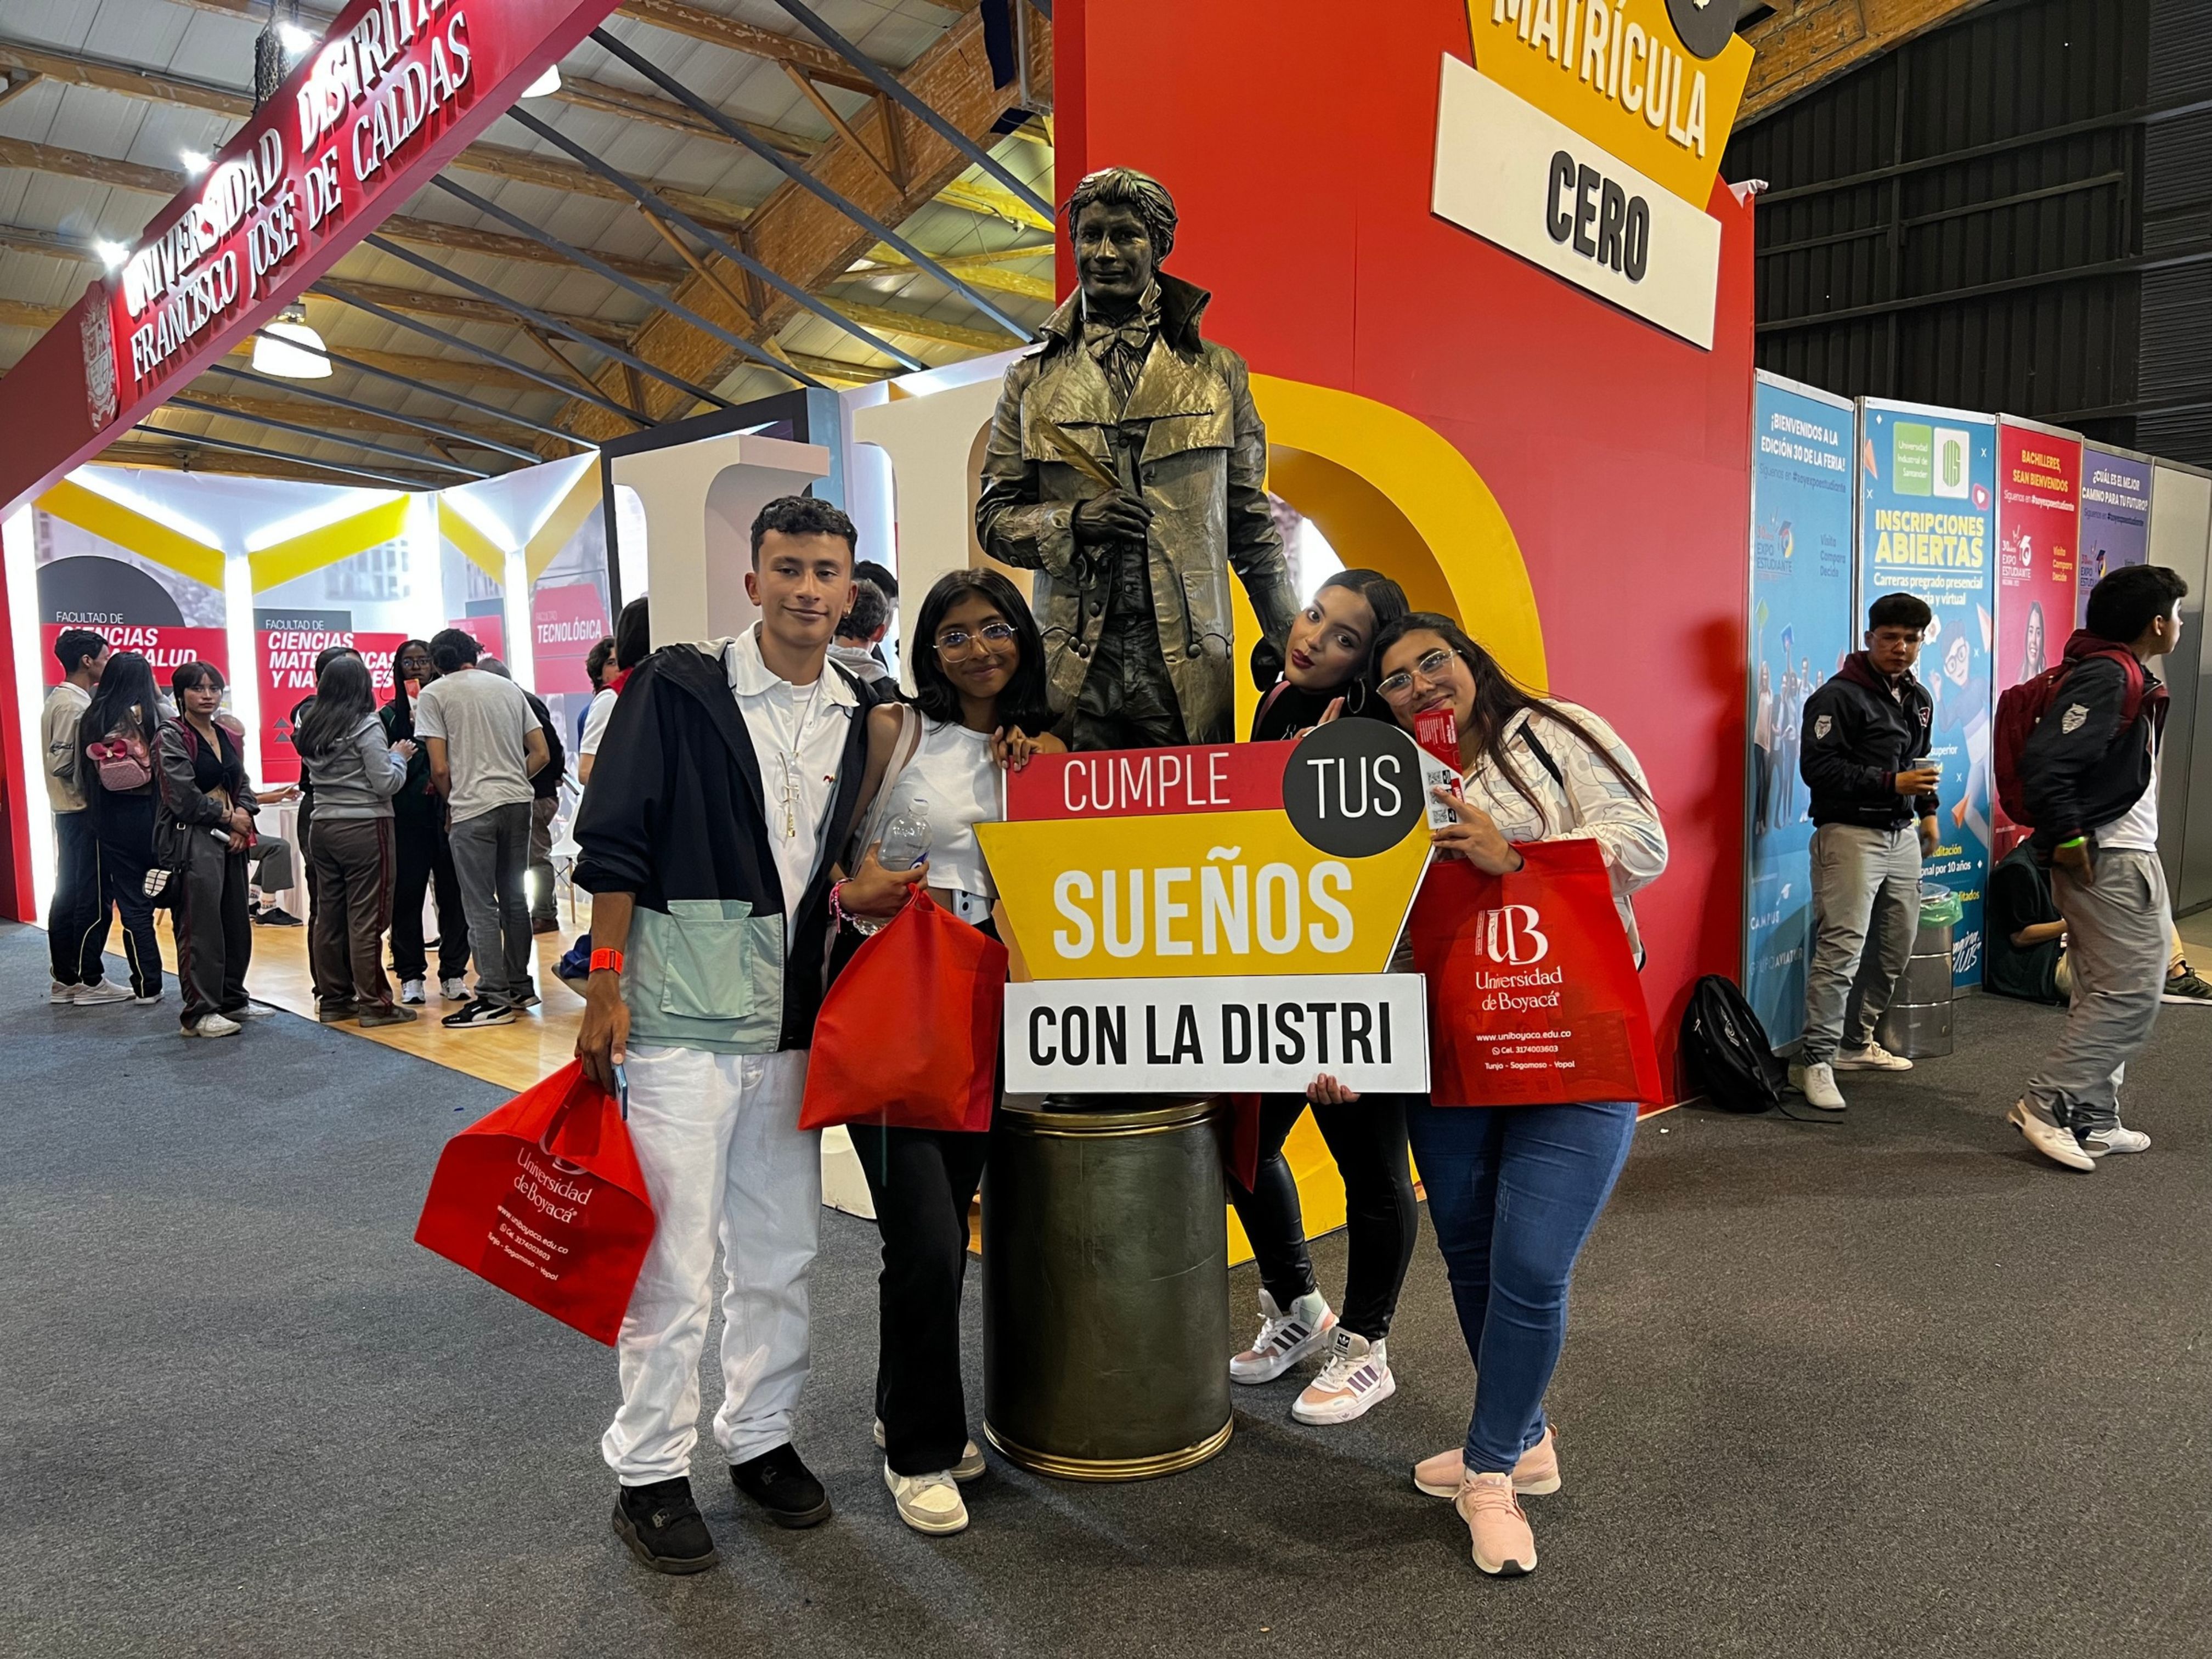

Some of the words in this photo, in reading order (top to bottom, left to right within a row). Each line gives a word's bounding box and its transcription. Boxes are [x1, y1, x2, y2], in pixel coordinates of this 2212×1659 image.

[122, 128, 284, 317] UNIVERSIDAD
[297, 0, 444, 154] DISTRIT
[130, 251, 238, 382] FRANCISCO
[246, 178, 298, 300] JOSÉ
[304, 145, 342, 231] DE
[352, 11, 471, 182] CALDAS
[1547, 150, 1650, 282] CERO
[1823, 428, 1829, 444] A
[1829, 430, 1838, 446] LA
[1761, 436, 1792, 459] EDICIÓN
[1793, 444, 1803, 461] 30
[1804, 448, 1814, 464] DE
[1814, 450, 1823, 467] LA
[1824, 453, 1846, 472] FERIA!
[2013, 469, 2029, 484] SEAN
[2030, 472, 2069, 493] BIENVENIDOS
[2111, 473, 2117, 486] ES
[2117, 475, 2122, 487] EL
[2123, 476, 2140, 491] MEJOR
[2082, 487, 2104, 503] CAMINO
[2105, 492, 2119, 506] PARA
[2120, 495, 2126, 507] TU
[1875, 509, 1984, 537] INSCRIPCIONES
[1757, 543, 1774, 556] EXPO
[1875, 531, 1983, 568] ABIERTAS
[1757, 557, 1792, 573] ESTUDIANTE
[1874, 572, 1909, 586] Carreras
[1910, 575, 1944, 590] pregrado
[1945, 576, 1983, 591] presencial
[1942, 592, 1966, 605] virtual
[56, 611, 108, 624] FACULTAD
[110, 613, 124, 624] DE
[266, 619, 311, 630] FACULTAD
[312, 620, 324, 630] DE
[537, 616, 602, 644] TECNOLÓGICA
[268, 632, 355, 650] CIENCIAS
[272, 670, 284, 689] Y
[1062, 751, 1232, 813] CUMPLE
[1306, 754, 1402, 820] TUS
[1935, 865, 1946, 877] por
[1947, 861, 1956, 873] 10
[1956, 860, 1971, 872] años
[1052, 845, 1355, 960] SUEÑOS
[1750, 910, 1780, 930] CAMPUS
[1482, 994, 1497, 1011] de
[1029, 1004, 1127, 1067] CON
[1146, 1003, 1204, 1066] LA
[1221, 1001, 1392, 1066] DISTRI
[1476, 1030, 1571, 1041] www.uniboyaca.edu.co
[1485, 1062, 1504, 1071] Tunja
[1510, 1061, 1547, 1070] Sogamoso
[1554, 1060, 1575, 1069] Yopal
[514, 1174, 529, 1194] de
[517, 1147, 593, 1205] Universidad
[504, 1245, 535, 1268] Sogamoso
[540, 1266, 559, 1281] Yopal
